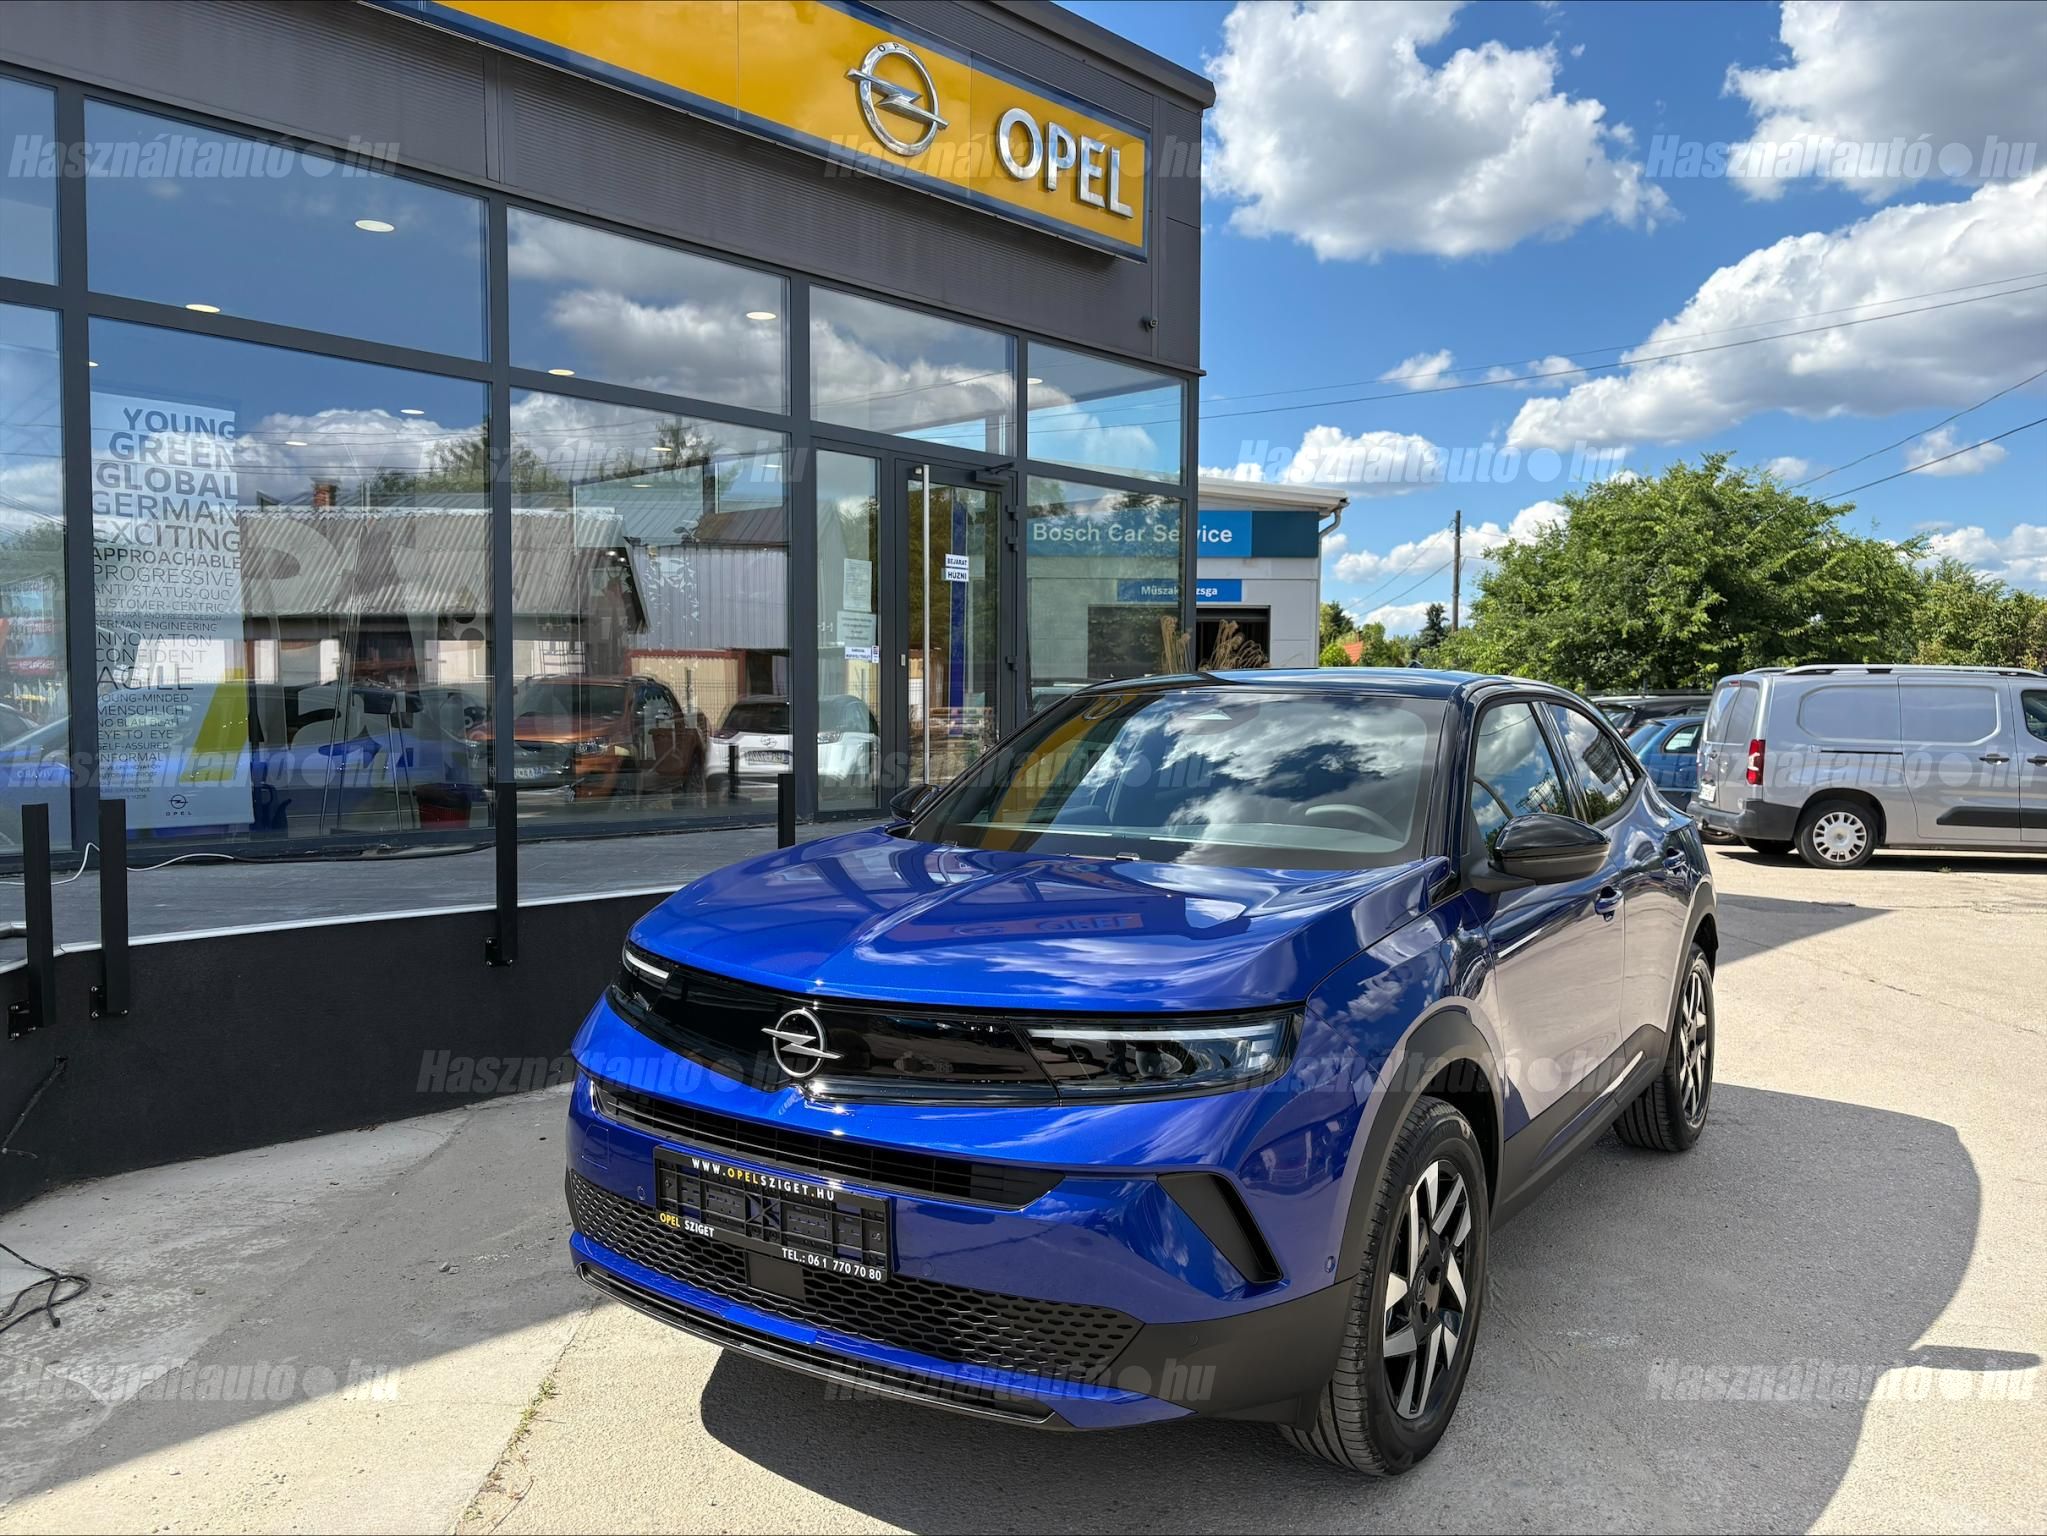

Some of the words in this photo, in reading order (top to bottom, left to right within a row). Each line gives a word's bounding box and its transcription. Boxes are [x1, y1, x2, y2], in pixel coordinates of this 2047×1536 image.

[995, 107, 1134, 219] OPEL
[123, 407, 236, 441] YOUNG
[109, 431, 234, 471] GREEN
[96, 462, 239, 500] GLOBAL
[92, 490, 240, 527] GERMAN
[92, 519, 241, 553] EXCITING
[1033, 522, 1100, 542] Bosch
[1108, 523, 1146, 542] Car
[1153, 524, 1233, 544] Sevice
[92, 546, 241, 570] APPROACHABLE
[132, 584, 230, 601] STATUS-QUO
[1141, 585, 1179, 596] Műszak
[1195, 587, 1218, 597] zsga
[144, 621, 217, 632] ENGINEERING
[97, 631, 212, 647] NNOVATION
[96, 665, 194, 690] AGILE
[98, 693, 189, 703] OUNG-MINDED
[97, 705, 184, 716] MENSCHLICH
[117, 718, 146, 727] BLAH
[124, 729, 143, 739] TO
[150, 729, 174, 739] EYE
[100, 752, 164, 763] NFORMAL
[691, 1157, 836, 1202] WWW.OPELSZIGET.HU
[659, 1212, 681, 1228] OPEL
[684, 1219, 715, 1238] SZIGET
[781, 1247, 806, 1264] TEL.:
[833, 1260, 852, 1274] 770
[853, 1265, 867, 1278] 70
[868, 1269, 882, 1281] 80
